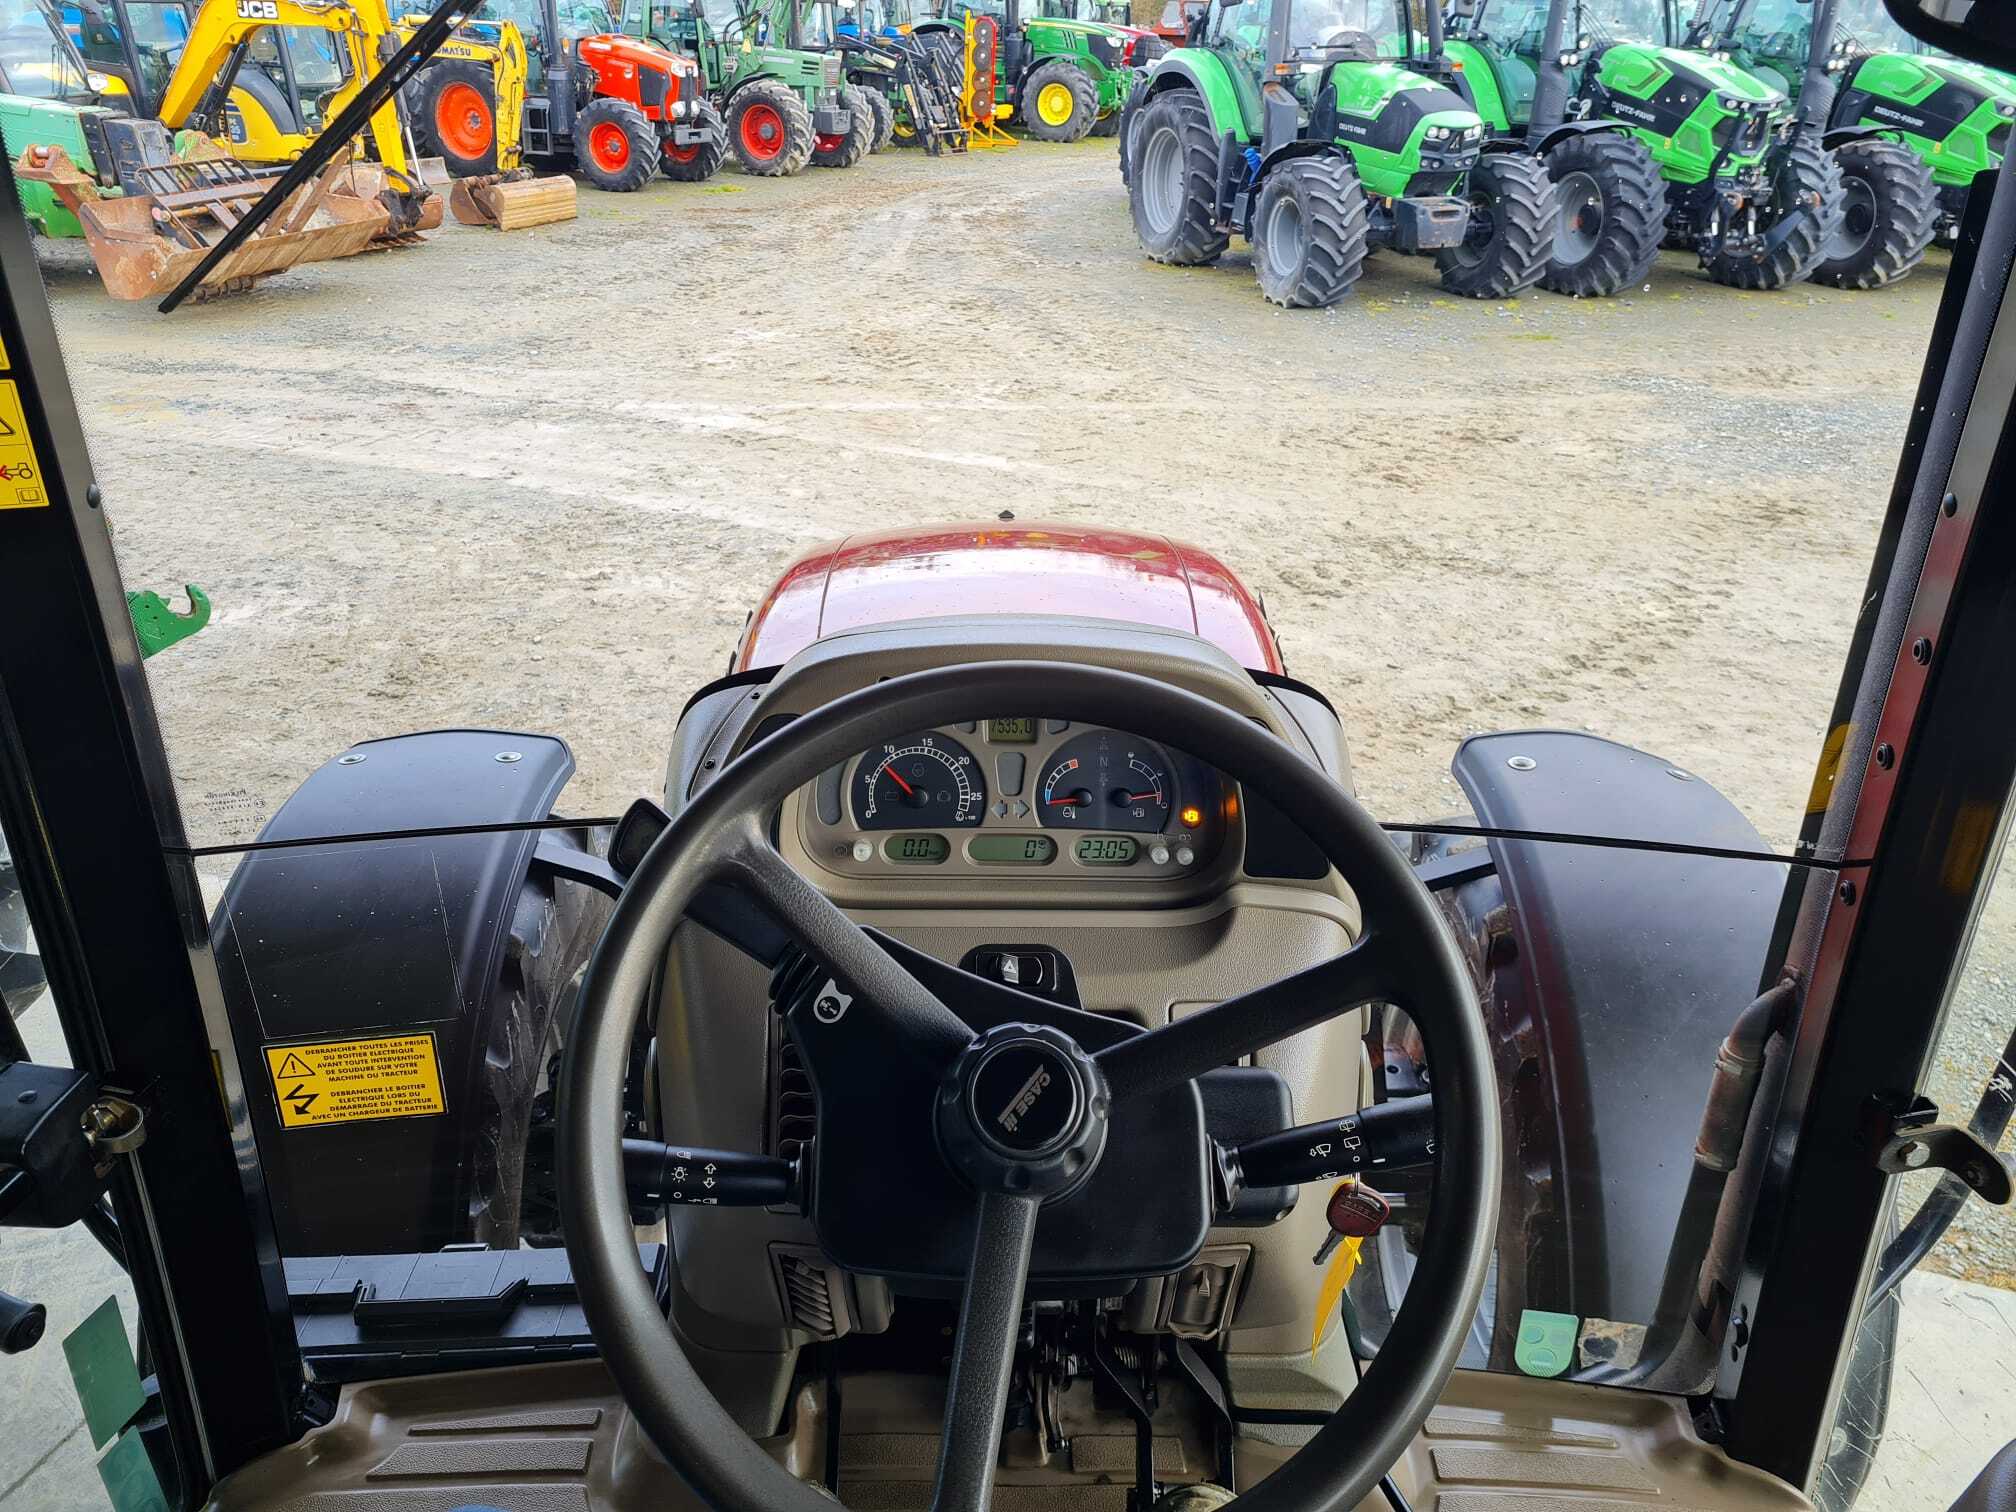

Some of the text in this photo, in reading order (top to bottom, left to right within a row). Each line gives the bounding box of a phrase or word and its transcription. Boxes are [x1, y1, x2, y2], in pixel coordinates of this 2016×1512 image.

[237, 0, 278, 18] JCB
[922, 739, 933, 747] 15
[884, 745, 895, 753] 10
[958, 757, 969, 765] 20
[865, 775, 871, 783] 5
[971, 792, 983, 801] 25
[865, 810, 872, 818] 0
[903, 839, 930, 857] 0.0
[1079, 840, 1129, 859] 23:05
[305, 1045, 356, 1055] DEBRANCHER
[370, 1048, 414, 1056] ELECTRIQUE
[371, 1054, 425, 1063] INTERVENTION
[329, 1074, 364, 1082] MACHINE
[382, 1069, 418, 1077] TRACTEUR
[330, 1088, 382, 1096] DEBRANCHER
[1016, 1073, 1051, 1117] CASE
[339, 1095, 384, 1103] ELECTRIQUE
[330, 1102, 379, 1111] DEMARRAGE
[349, 1108, 390, 1116] CHARGEUR
